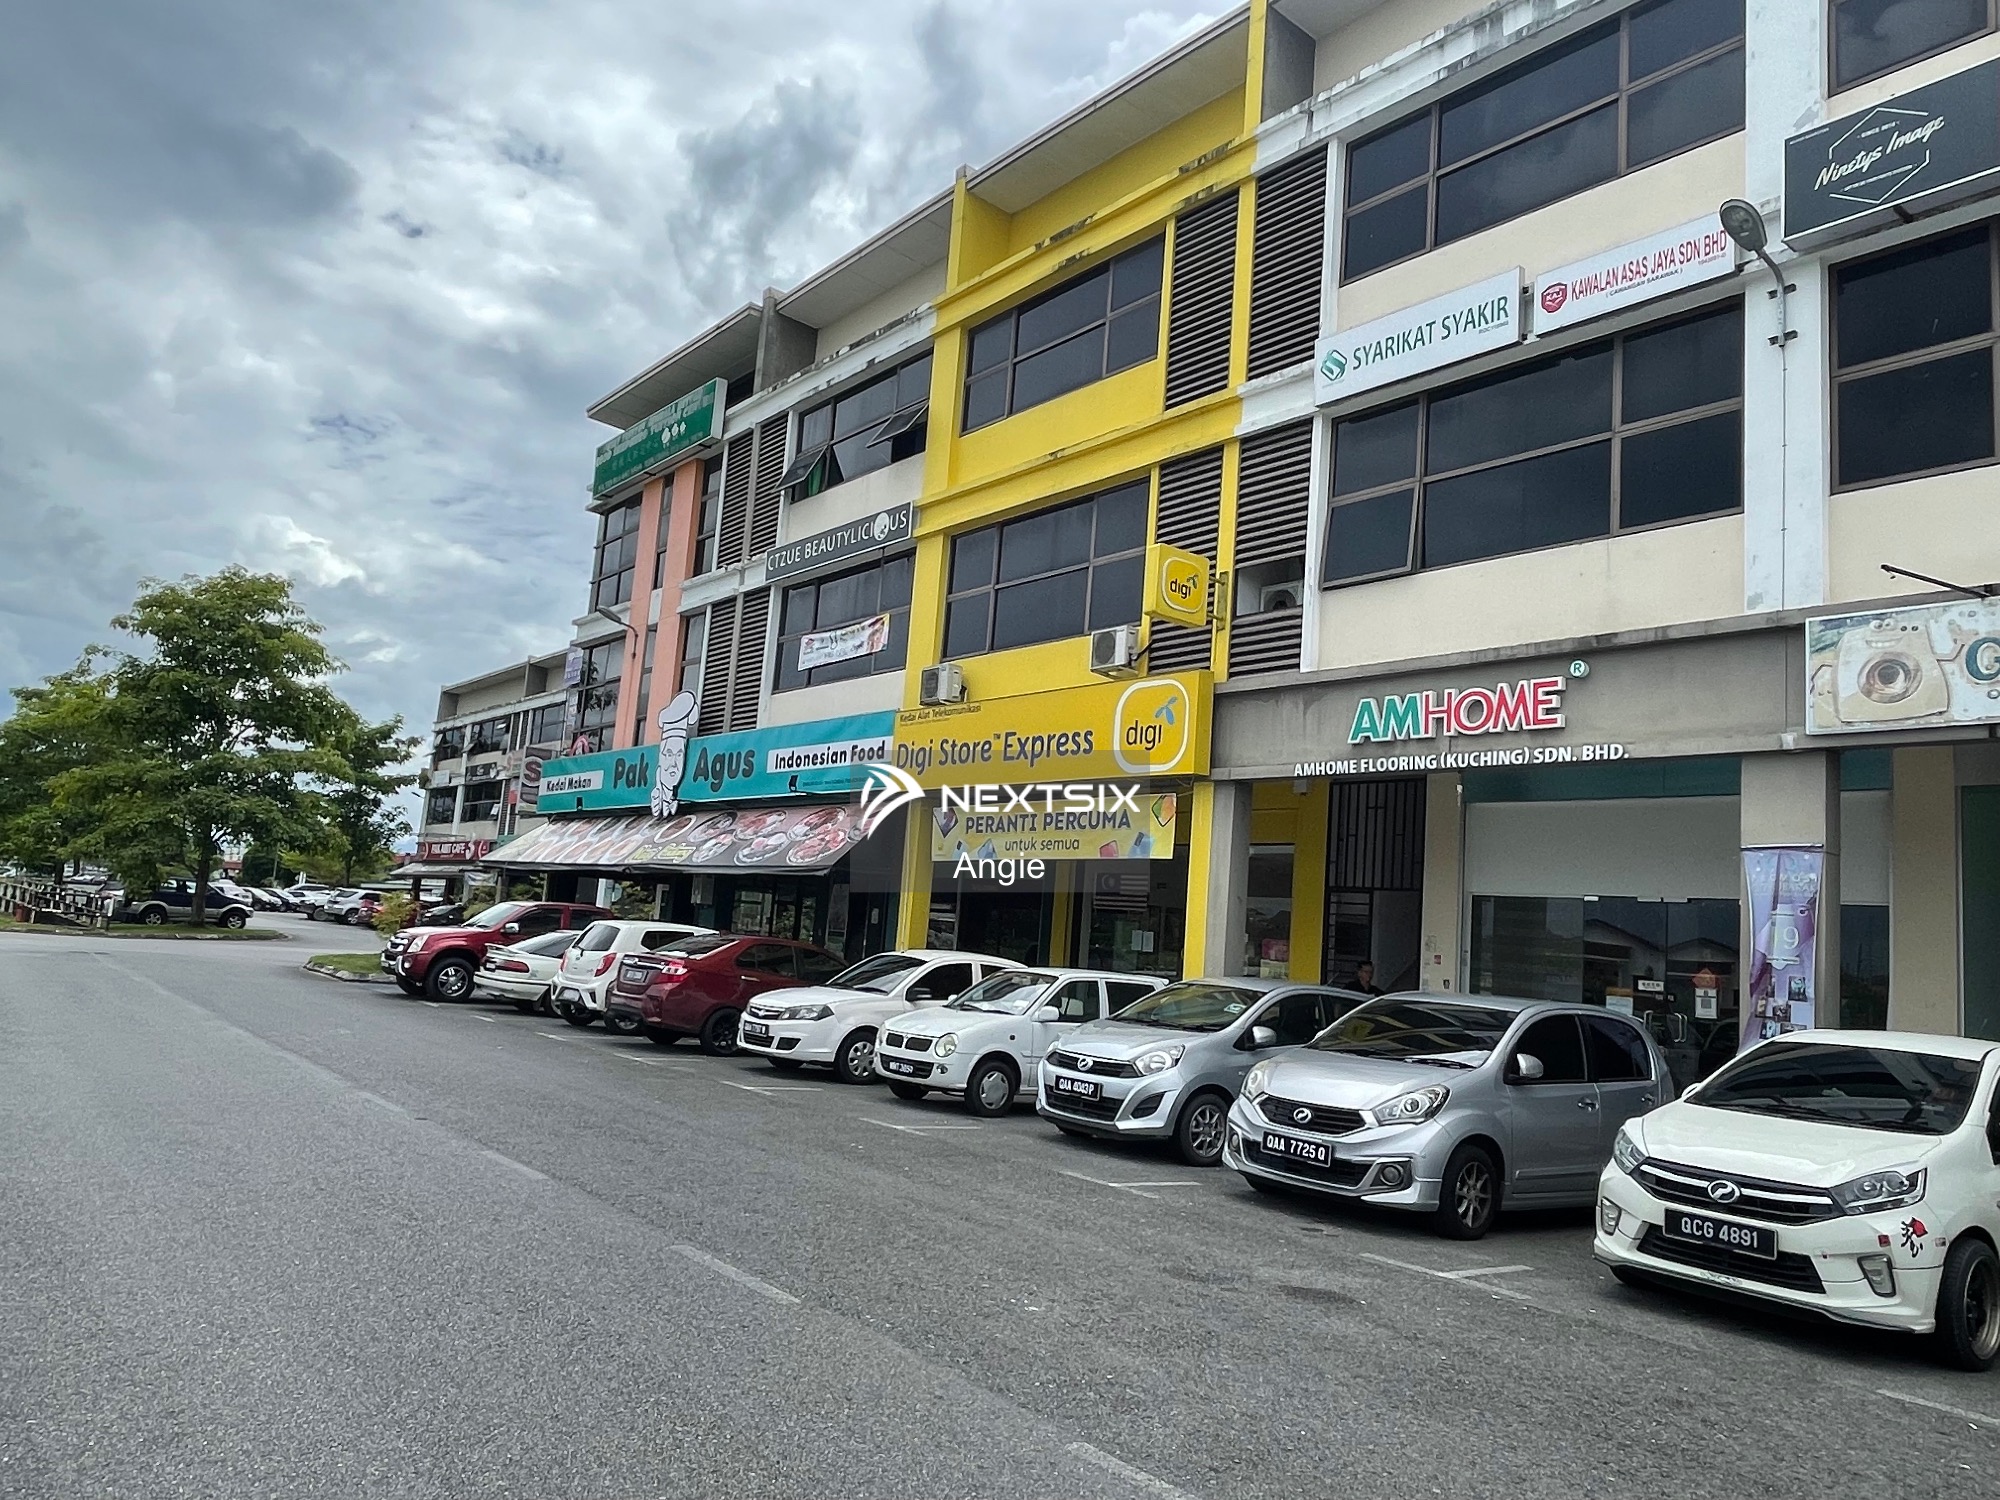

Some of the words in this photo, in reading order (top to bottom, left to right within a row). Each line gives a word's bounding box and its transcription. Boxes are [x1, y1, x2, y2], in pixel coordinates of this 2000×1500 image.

[1814, 146, 1884, 190] Ninetys
[1886, 116, 1945, 155] Image
[1571, 267, 1619, 301] KAWALAN
[1621, 256, 1648, 285] ASAS
[1651, 246, 1677, 274] JAYA
[1678, 238, 1701, 265] SDN
[1704, 229, 1727, 257] BHD
[1353, 320, 1437, 371] SYARIKAT
[1441, 295, 1509, 341] SYAKIR
[767, 544, 802, 571] CTZUE
[1169, 578, 1191, 600] digi
[1347, 676, 1566, 744] AMHOME
[1125, 721, 1163, 750] digi
[775, 749, 847, 770] Indonesian
[850, 740, 885, 763] Food
[896, 738, 934, 775] Digi
[1002, 729, 1094, 767] Express
[1294, 759, 1358, 777] AMHOME
[1360, 754, 1437, 774] FLOORING
[1440, 746, 1530, 769] (KUCHING)
[1533, 747, 1577, 764] SDN.
[1582, 743, 1629, 761] BHD.
[546, 777, 566, 792] Kedai
[567, 777, 592, 790] Makan
[613, 752, 649, 789] Pak
[692, 747, 756, 793] Agus
[965, 813, 1038, 834] PERANTI
[1043, 809, 1131, 832] PERCUMA
[1004, 838, 1037, 852] untuk
[1040, 837, 1080, 851] semua
[1266, 1135, 1285, 1151] QAA
[1681, 1217, 1714, 1238] QCG
[1719, 1225, 1758, 1248] 4891
